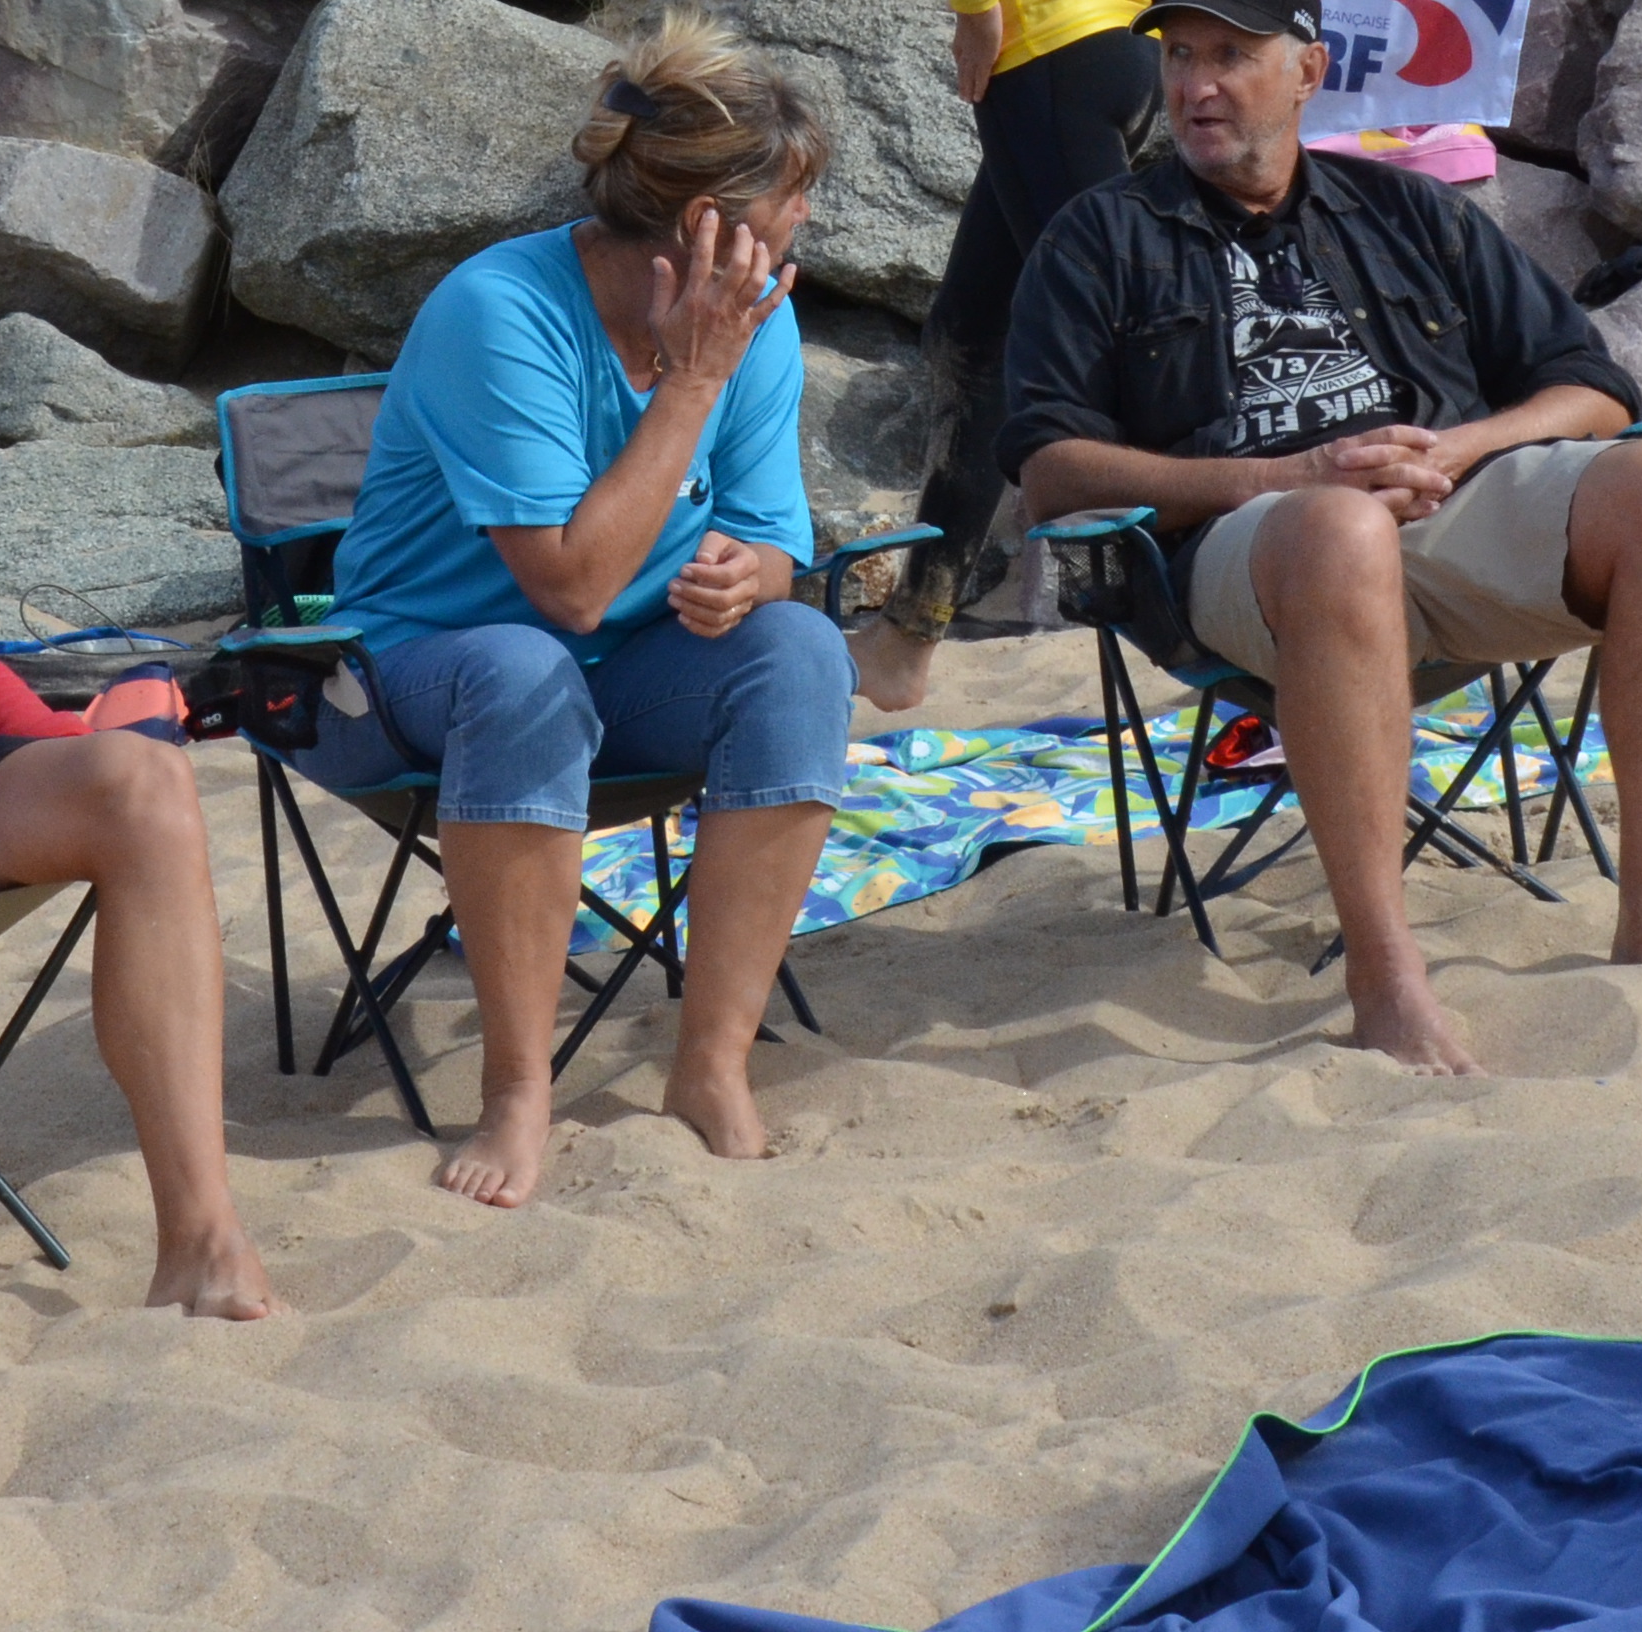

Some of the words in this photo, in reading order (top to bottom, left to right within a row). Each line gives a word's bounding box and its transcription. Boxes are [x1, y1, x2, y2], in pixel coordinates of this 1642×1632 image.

[1323, 8, 1391, 30] RANÇAISE
[1321, 29, 1388, 93] RF
[1268, 357, 1307, 379] 73
[1312, 368, 1367, 393] WATERS
